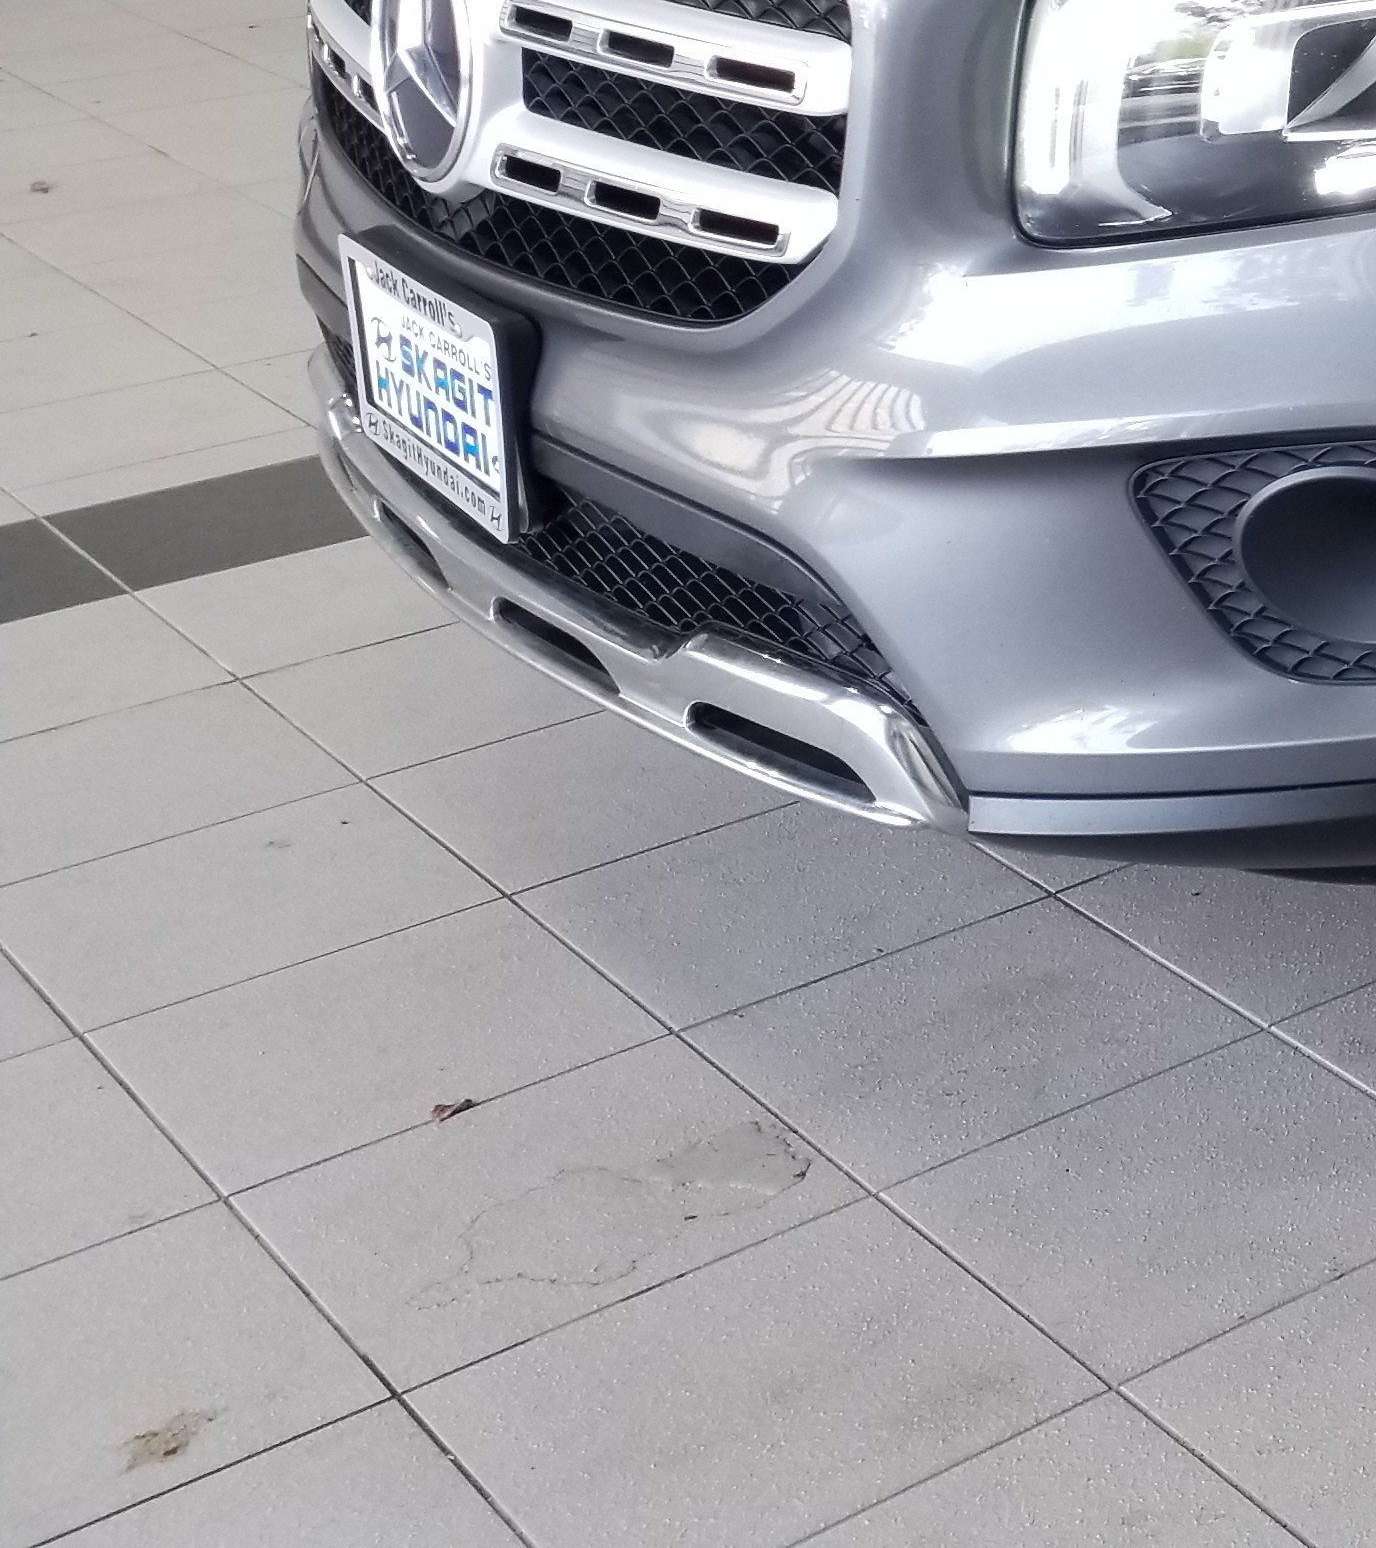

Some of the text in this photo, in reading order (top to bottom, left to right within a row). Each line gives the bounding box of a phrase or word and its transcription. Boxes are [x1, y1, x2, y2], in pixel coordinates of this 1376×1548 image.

[374, 260, 456, 327] Jack Carroll's
[399, 333, 494, 428] SKAGIT
[401, 315, 492, 382] JACK CARROLL'S
[375, 360, 491, 477] HYUNDAI
[382, 419, 486, 515] SkagitHyundai.com
